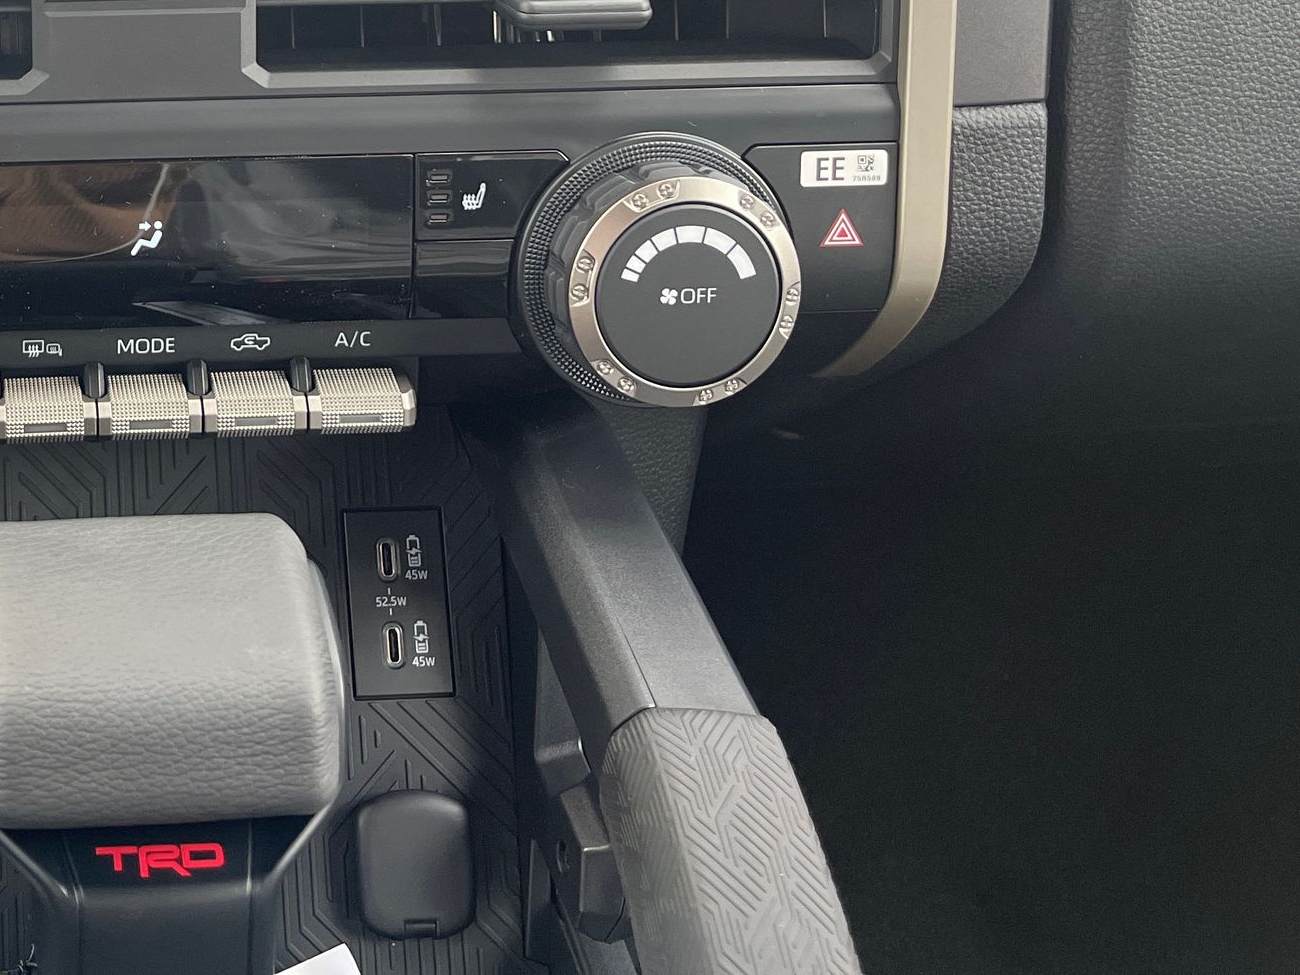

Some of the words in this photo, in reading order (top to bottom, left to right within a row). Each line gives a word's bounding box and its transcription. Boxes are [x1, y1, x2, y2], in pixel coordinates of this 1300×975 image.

[815, 156, 846, 182] EE
[680, 287, 718, 305] OFF
[116, 336, 176, 355] MODE
[334, 330, 372, 349] A/C
[404, 569, 429, 580] 45W
[375, 596, 408, 608] 52.5W
[412, 656, 436, 667] 45W
[94, 842, 226, 880] TRD
